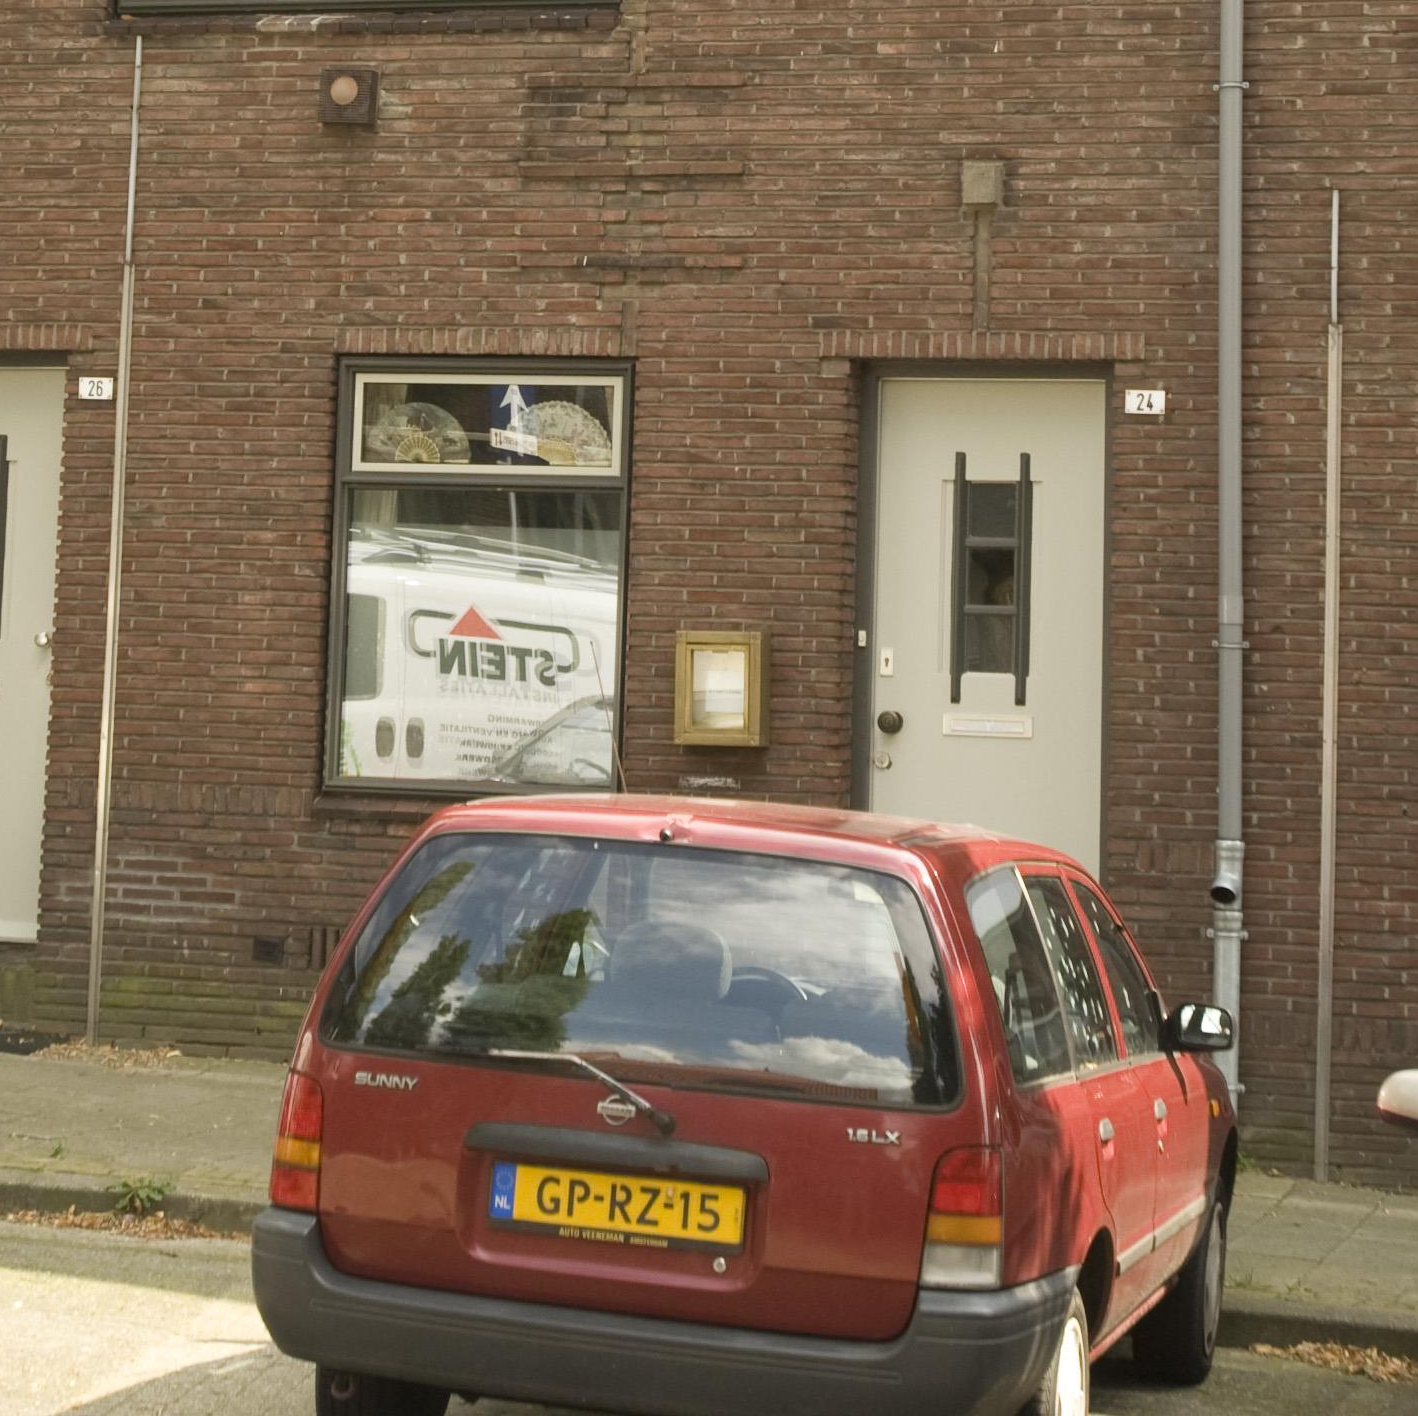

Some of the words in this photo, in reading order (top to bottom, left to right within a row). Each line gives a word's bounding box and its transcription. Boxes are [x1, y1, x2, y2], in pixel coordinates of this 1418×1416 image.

[88, 380, 103, 397] 26
[1136, 393, 1154, 412] 24
[354, 1071, 418, 1091] SUNNY
[494, 1195, 510, 1210] NL
[536, 1176, 720, 1233] GP-RZ-15
[559, 1227, 580, 1239] AUTO
